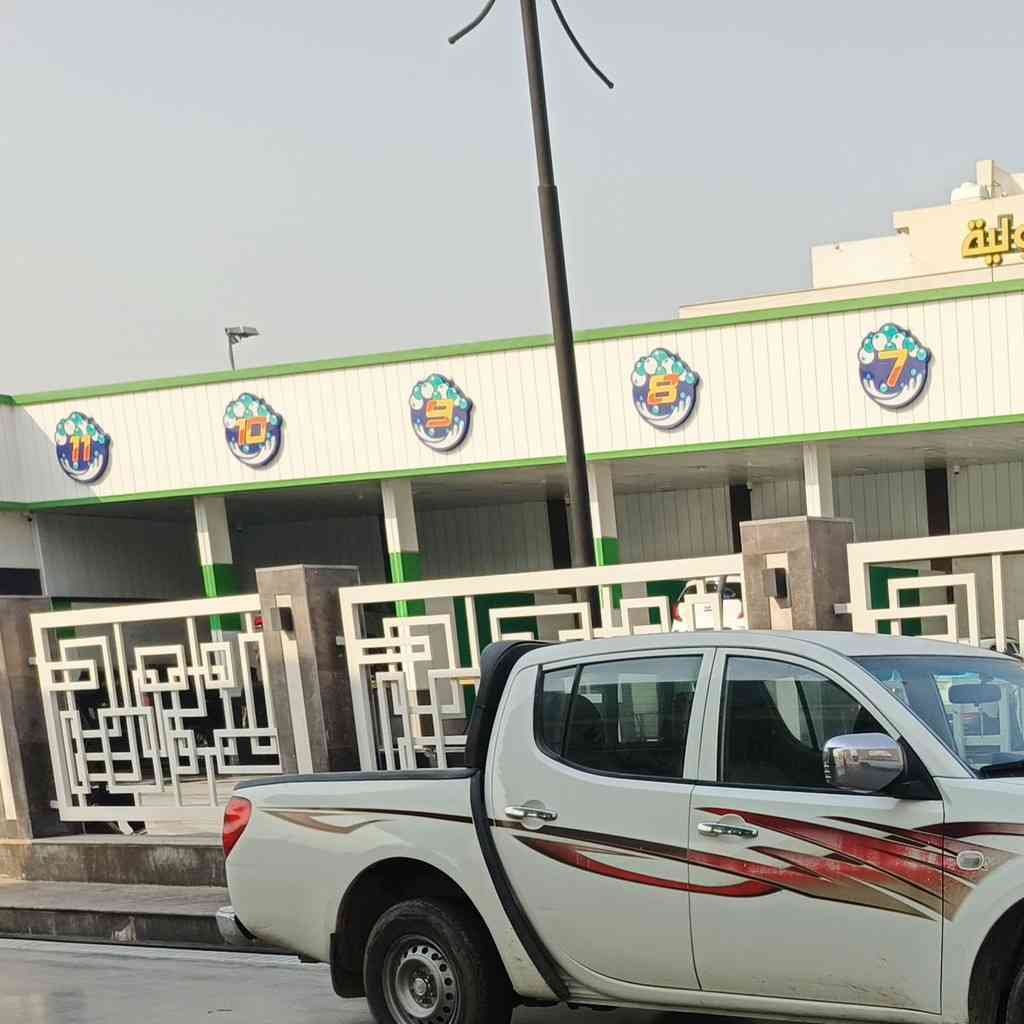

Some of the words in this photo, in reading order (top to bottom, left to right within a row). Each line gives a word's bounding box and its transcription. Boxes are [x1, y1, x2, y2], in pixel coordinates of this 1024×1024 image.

[878, 348, 908, 388] 7
[646, 374, 681, 405] 8
[424, 399, 455, 429] 9
[235, 415, 268, 446] 10
[70, 434, 92, 464] 11
